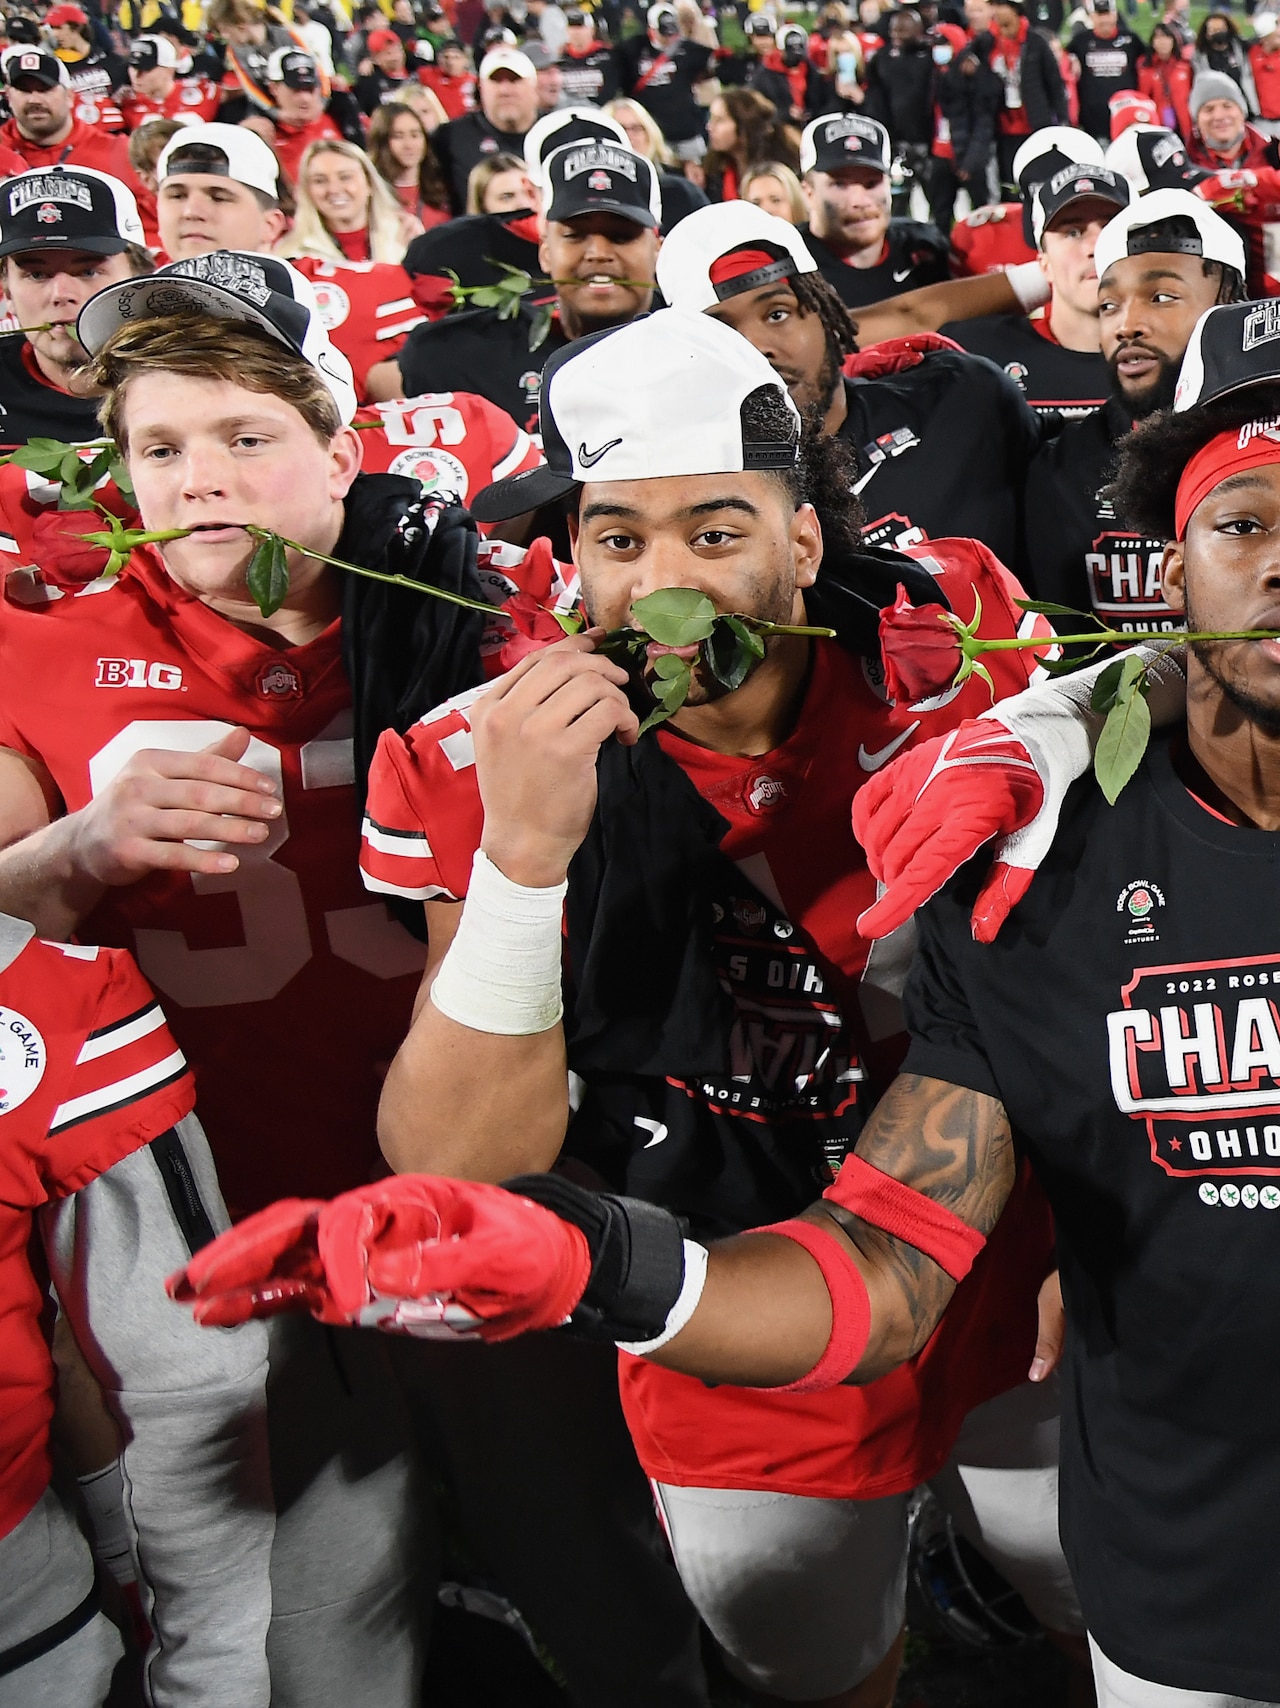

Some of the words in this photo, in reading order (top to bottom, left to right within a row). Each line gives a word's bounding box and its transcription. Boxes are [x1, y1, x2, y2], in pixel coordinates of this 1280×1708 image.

[9, 179, 93, 216] CHAMPS
[119, 291, 135, 319] ROSE
[1085, 552, 1164, 611] CHA
[1127, 880, 1150, 891] BOWL
[1166, 977, 1217, 994] 2022
[10, 1021, 39, 1068] GAME
